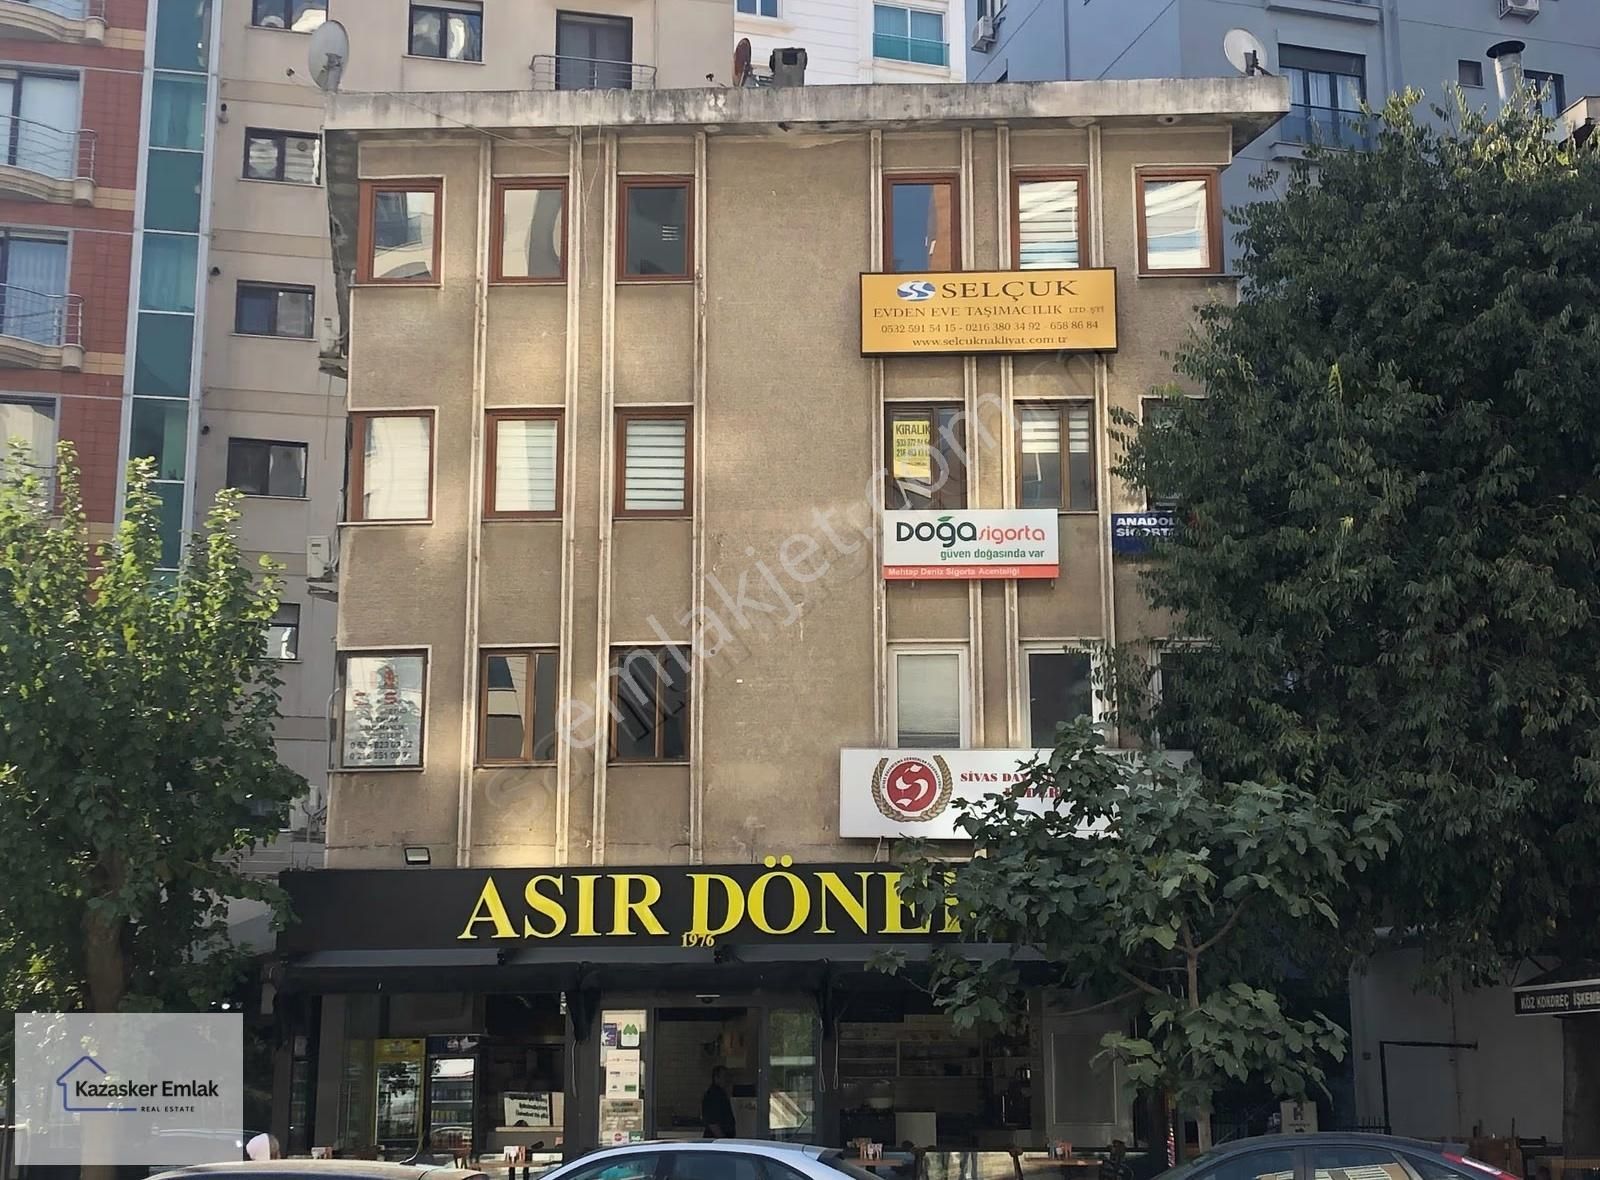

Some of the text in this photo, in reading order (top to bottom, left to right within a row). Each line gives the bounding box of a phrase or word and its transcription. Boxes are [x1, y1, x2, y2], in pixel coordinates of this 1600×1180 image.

[941, 280, 1079, 302] SELÇUK
[873, 307, 926, 318] EVDEN
[931, 306, 960, 317] EVE
[881, 324, 906, 334] 0532
[908, 323, 925, 333] 591
[929, 323, 941, 333] 54
[945, 323, 957, 332] 15
[965, 322, 990, 332] 0216
[992, 322, 1011, 332] 380
[1013, 322, 1026, 331] 34
[1028, 321, 1041, 331] 92
[1050, 321, 1069, 330] 658
[1071, 320, 1084, 330] 86
[1086, 320, 1099, 329] 84
[1116, 517, 1176, 526] ANADOL
[979, 525, 1045, 544] sigorta
[940, 548, 1045, 560] güven doğasında var
[888, 568, 919, 577] Mehtap
[945, 567, 976, 577] Sigorta
[960, 770, 998, 782] SİVAS
[457, 874, 670, 939] ASIR
[680, 932, 716, 948] 1976
